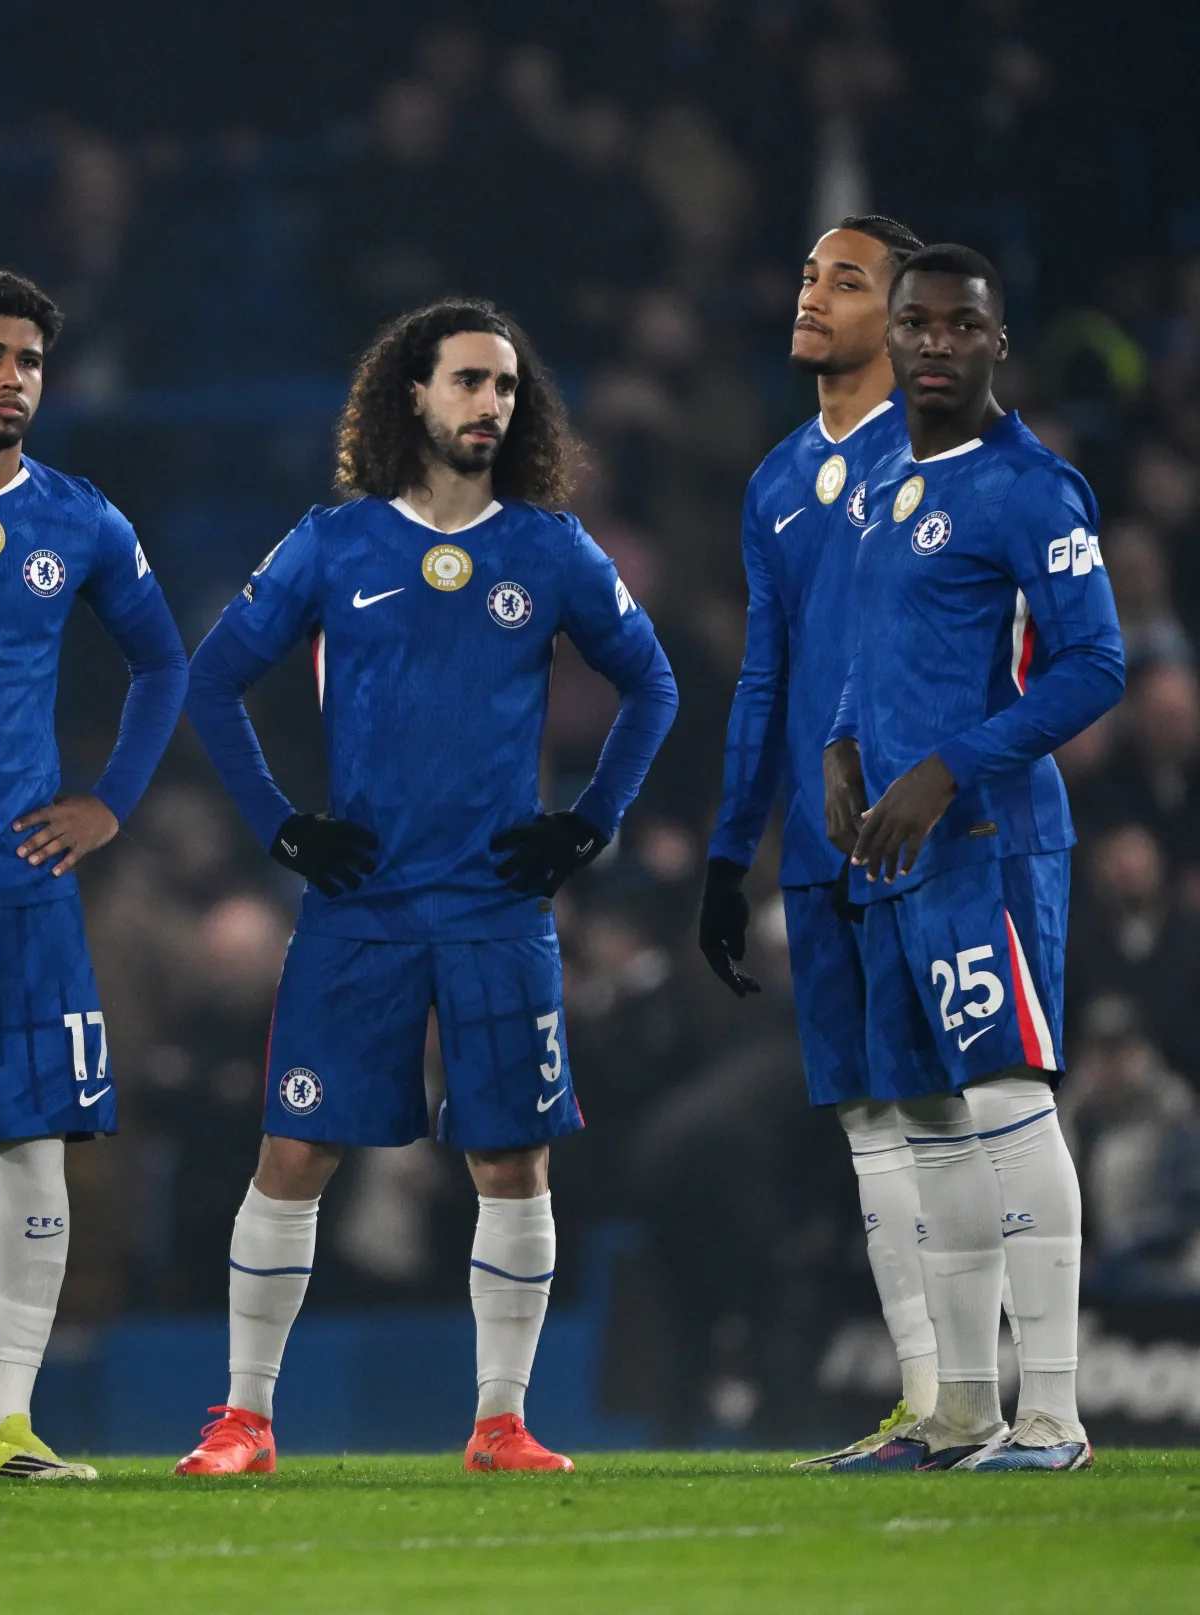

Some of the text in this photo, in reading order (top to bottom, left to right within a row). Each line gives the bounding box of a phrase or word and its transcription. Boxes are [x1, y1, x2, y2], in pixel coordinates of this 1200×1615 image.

[30, 551, 59, 563] CHELSEA
[427, 551, 440, 572] WORLD
[438, 579, 457, 587] FIFA
[496, 583, 525, 596] CHELSEA
[931, 944, 1005, 1031] 25
[63, 1011, 108, 1081] 17
[536, 1010, 561, 1082] 3
[289, 1069, 316, 1082] CHELSEA
[27, 1216, 64, 1228] CFC
